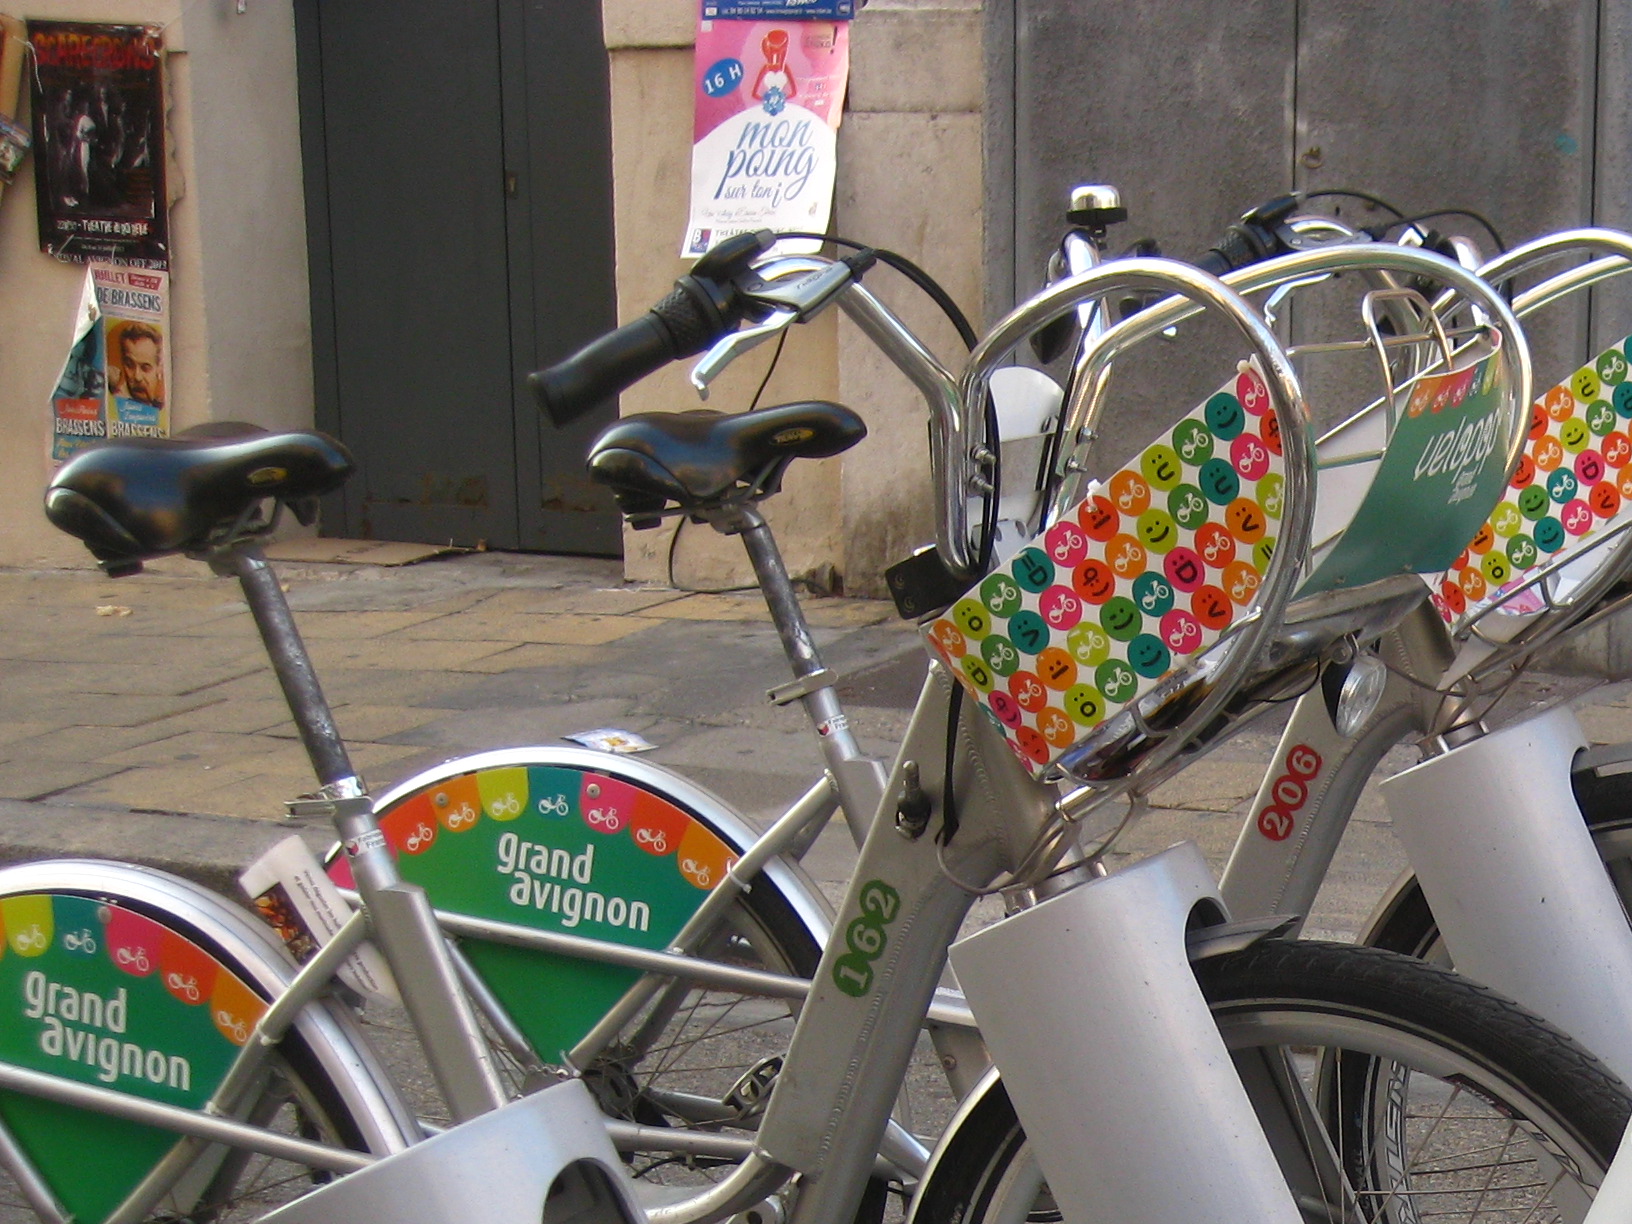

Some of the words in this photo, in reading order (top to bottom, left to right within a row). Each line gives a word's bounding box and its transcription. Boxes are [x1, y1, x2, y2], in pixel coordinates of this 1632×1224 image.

[704, 73, 725, 95] 16
[728, 63, 742, 80] H
[736, 119, 814, 149] mon
[713, 146, 820, 201] poing
[724, 184, 747, 200] sur
[750, 179, 772, 199] ton
[110, 288, 161, 313] BRASSENS
[56, 418, 106, 437] BRASSENS
[1261, 748, 1320, 838] 206
[497, 832, 595, 885] grand
[509, 871, 651, 932] avignon
[837, 883, 898, 993] 162
[25, 970, 128, 1034] grand
[40, 1015, 192, 1092] avignon
